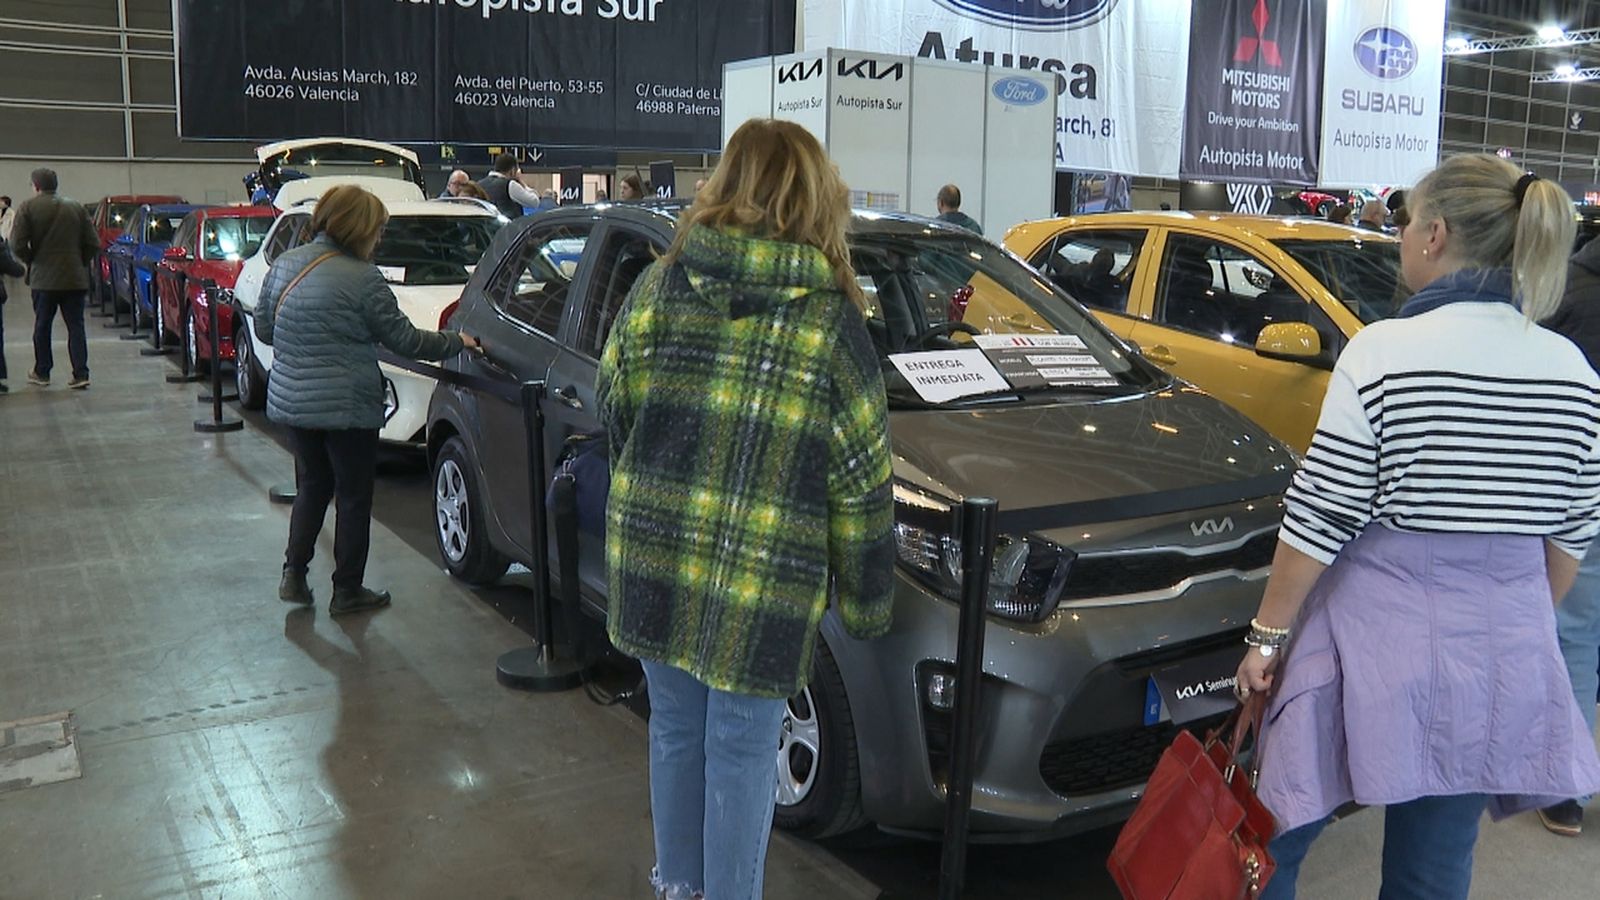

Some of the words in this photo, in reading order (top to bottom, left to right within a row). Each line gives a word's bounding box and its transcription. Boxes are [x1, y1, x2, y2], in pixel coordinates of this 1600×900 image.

[245, 65, 286, 80] Avda.
[291, 67, 338, 82] Ausias
[343, 69, 390, 86] March,
[394, 72, 417, 85] 182
[778, 58, 823, 84] KIA
[837, 57, 903, 81] KIA
[455, 74, 492, 89] Avda.
[496, 77, 515, 90] del
[520, 77, 564, 93] Puerto,
[568, 80, 603, 94] 53-55
[1222, 68, 1290, 92] MITSUBISHI
[245, 84, 294, 98] 46026
[299, 85, 359, 101] Valencia
[455, 92, 497, 106] 46023
[501, 94, 555, 108] Valencia
[636, 83, 650, 97] C/
[653, 84, 693, 98] Ciudad
[696, 87, 711, 99] de
[1003, 81, 1037, 101] Ford
[1231, 88, 1281, 110] MOTORS
[636, 100, 674, 114] 46988
[677, 102, 721, 117] Paterna
[778, 99, 809, 112] Autopista
[811, 96, 823, 108] Sur
[837, 95, 885, 110] Autopista
[886, 98, 903, 111] Sur
[1341, 88, 1424, 116] SUBARU
[1208, 111, 1234, 127] Drive
[1235, 117, 1256, 130] your
[1258, 116, 1299, 133] Ambition
[1333, 127, 1392, 153] Autopista
[1394, 132, 1429, 152] Motor
[1199, 144, 1264, 171] Autopista
[1266, 149, 1304, 170] Motor
[904, 359, 965, 371] ENTREGA
[916, 373, 985, 385] INMEDIATA
[1190, 516, 1235, 537] KIA
[1176, 682, 1205, 700] KIA
